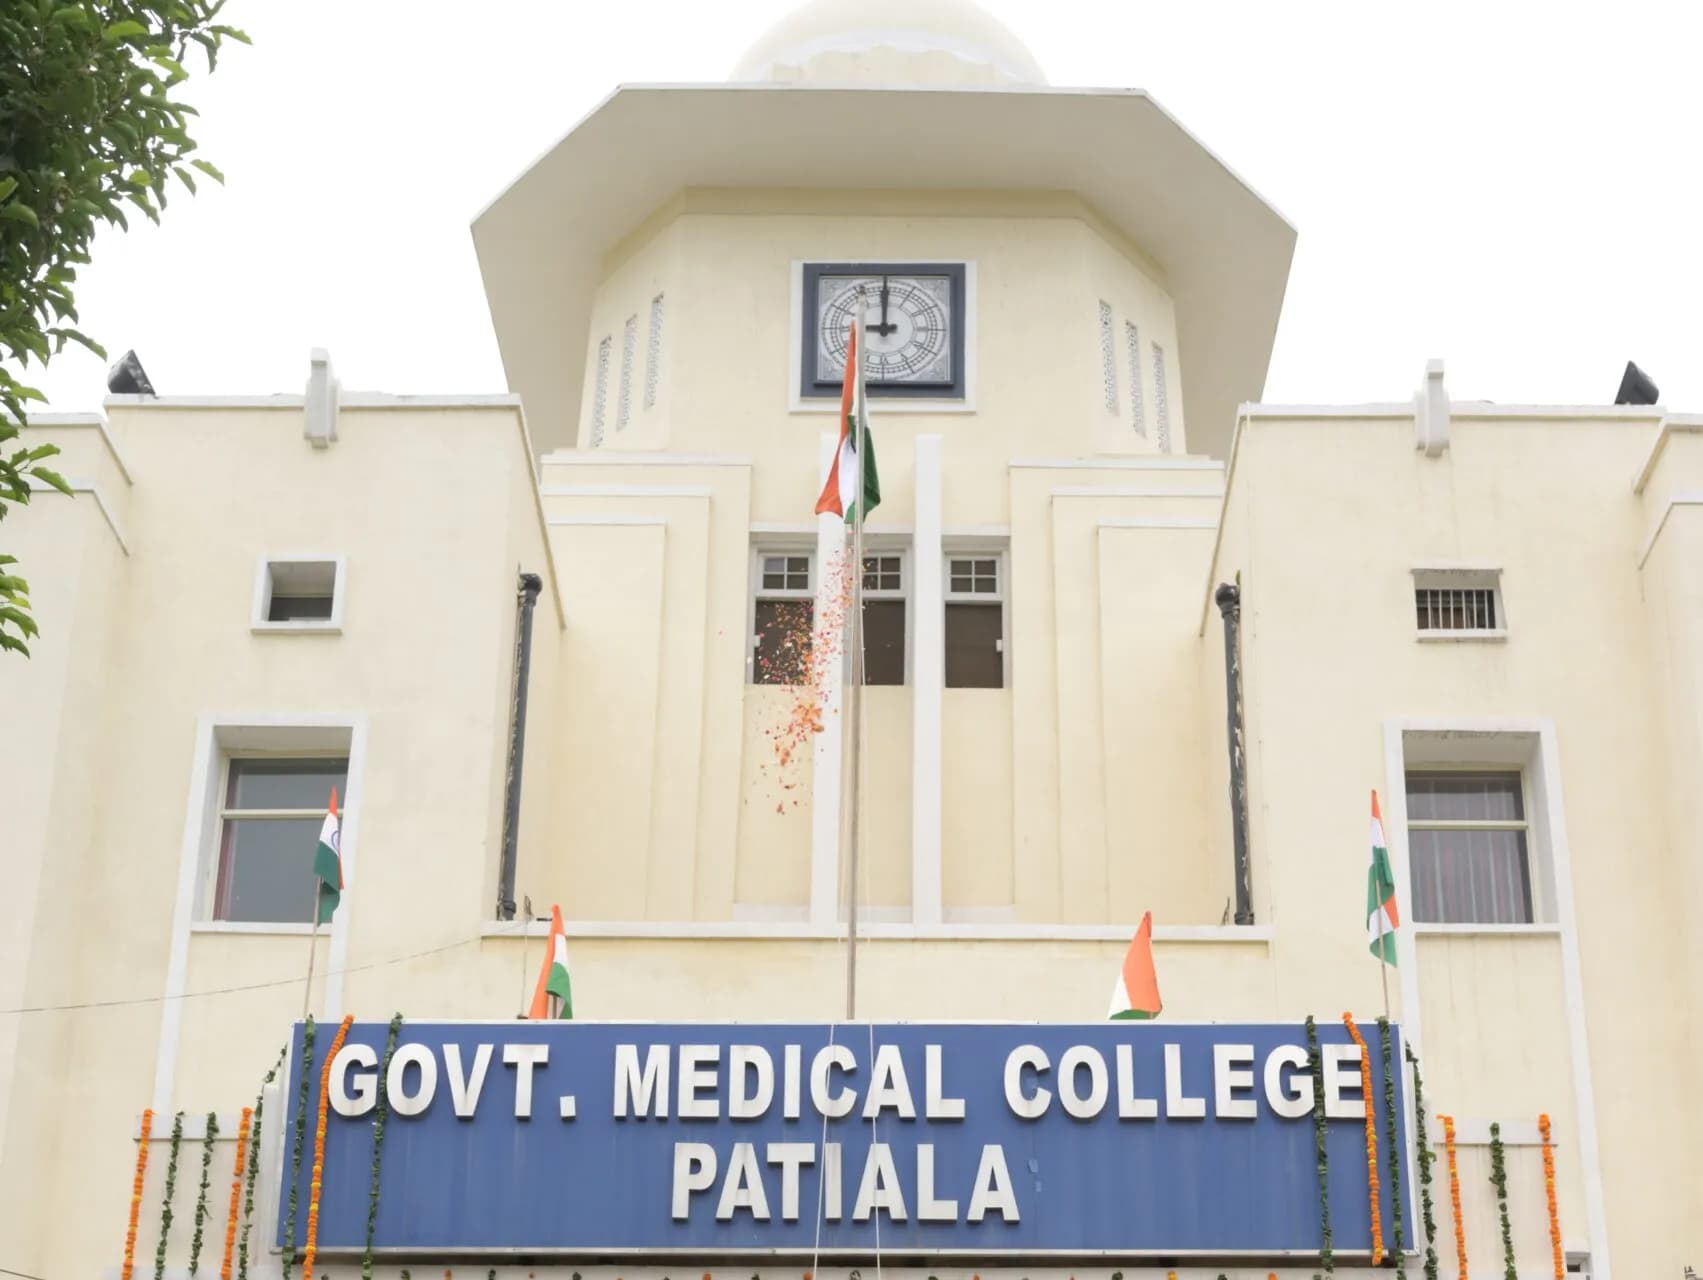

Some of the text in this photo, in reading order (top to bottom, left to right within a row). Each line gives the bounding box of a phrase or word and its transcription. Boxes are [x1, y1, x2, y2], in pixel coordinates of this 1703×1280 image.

[328, 1043, 1367, 1120] GOVT. MEDICAL COLLEGE
[671, 1142, 1021, 1223] PATIALA
